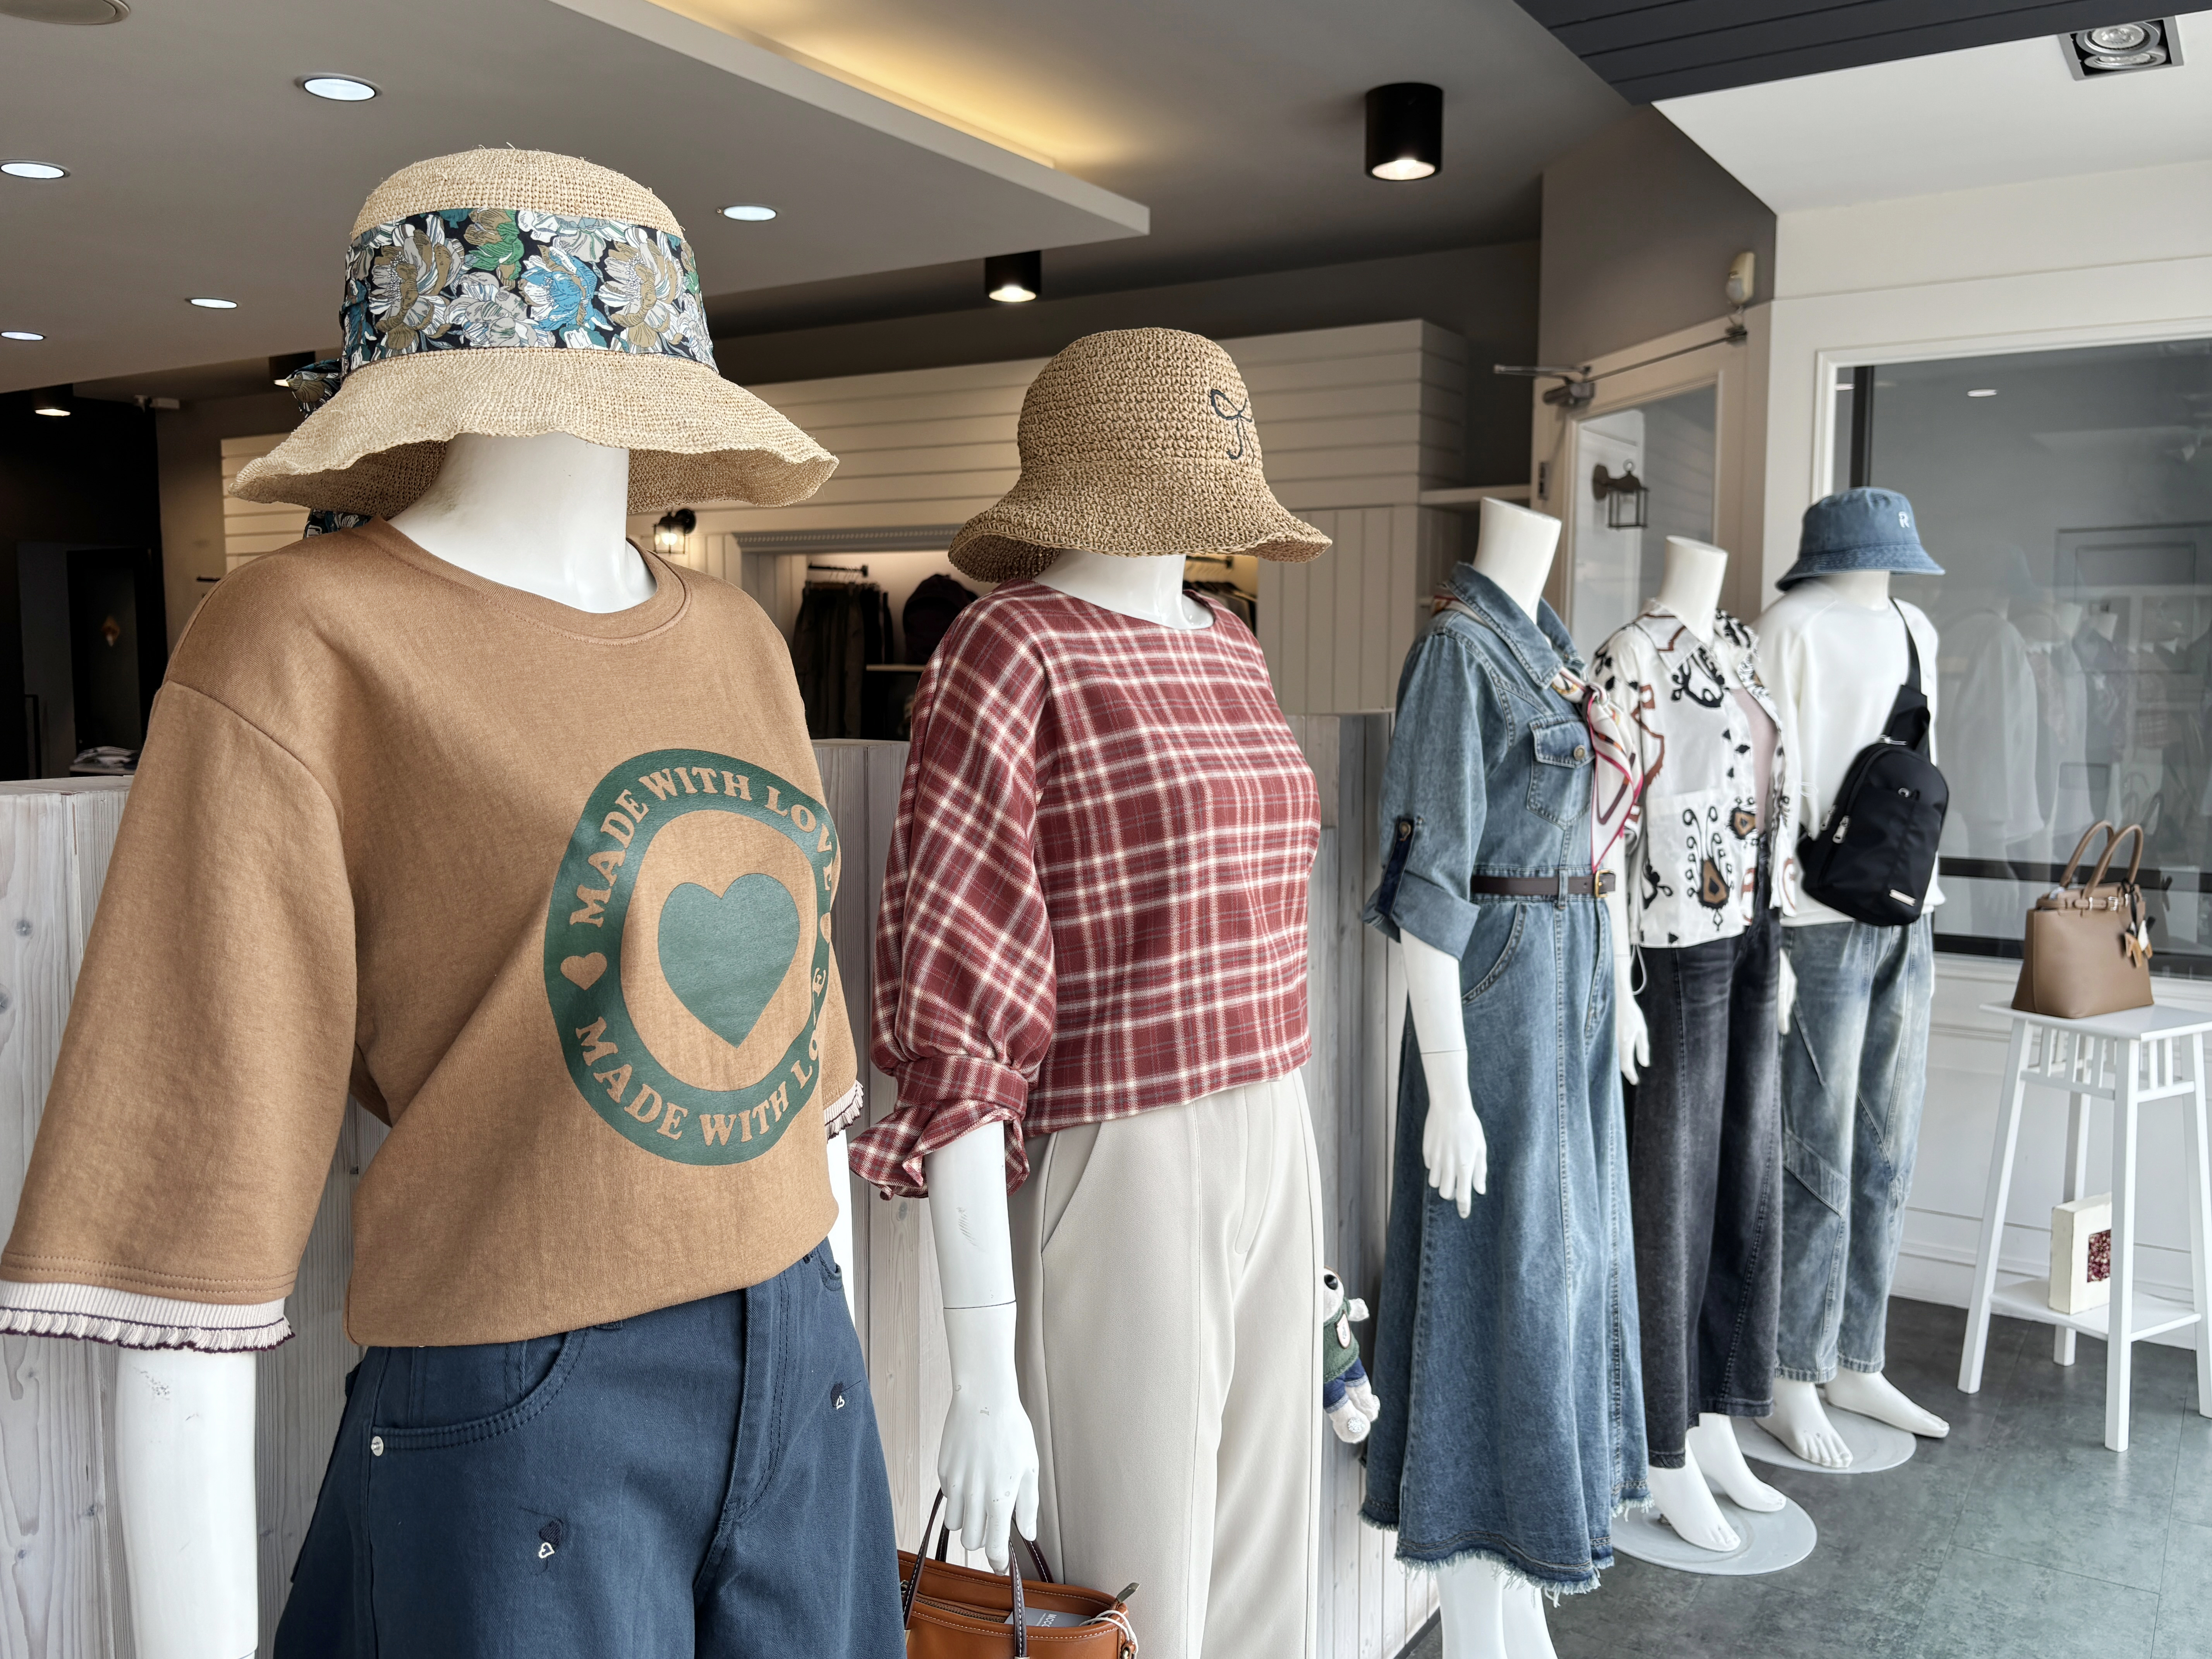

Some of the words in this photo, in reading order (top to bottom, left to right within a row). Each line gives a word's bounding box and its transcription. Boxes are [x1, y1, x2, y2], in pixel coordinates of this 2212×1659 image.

[1898, 511, 1910, 528] R
[570, 789, 649, 928] MADE
[638, 766, 753, 801] WITH
[575, 1017, 688, 1140] MADE
[699, 1081, 789, 1146] WITH
